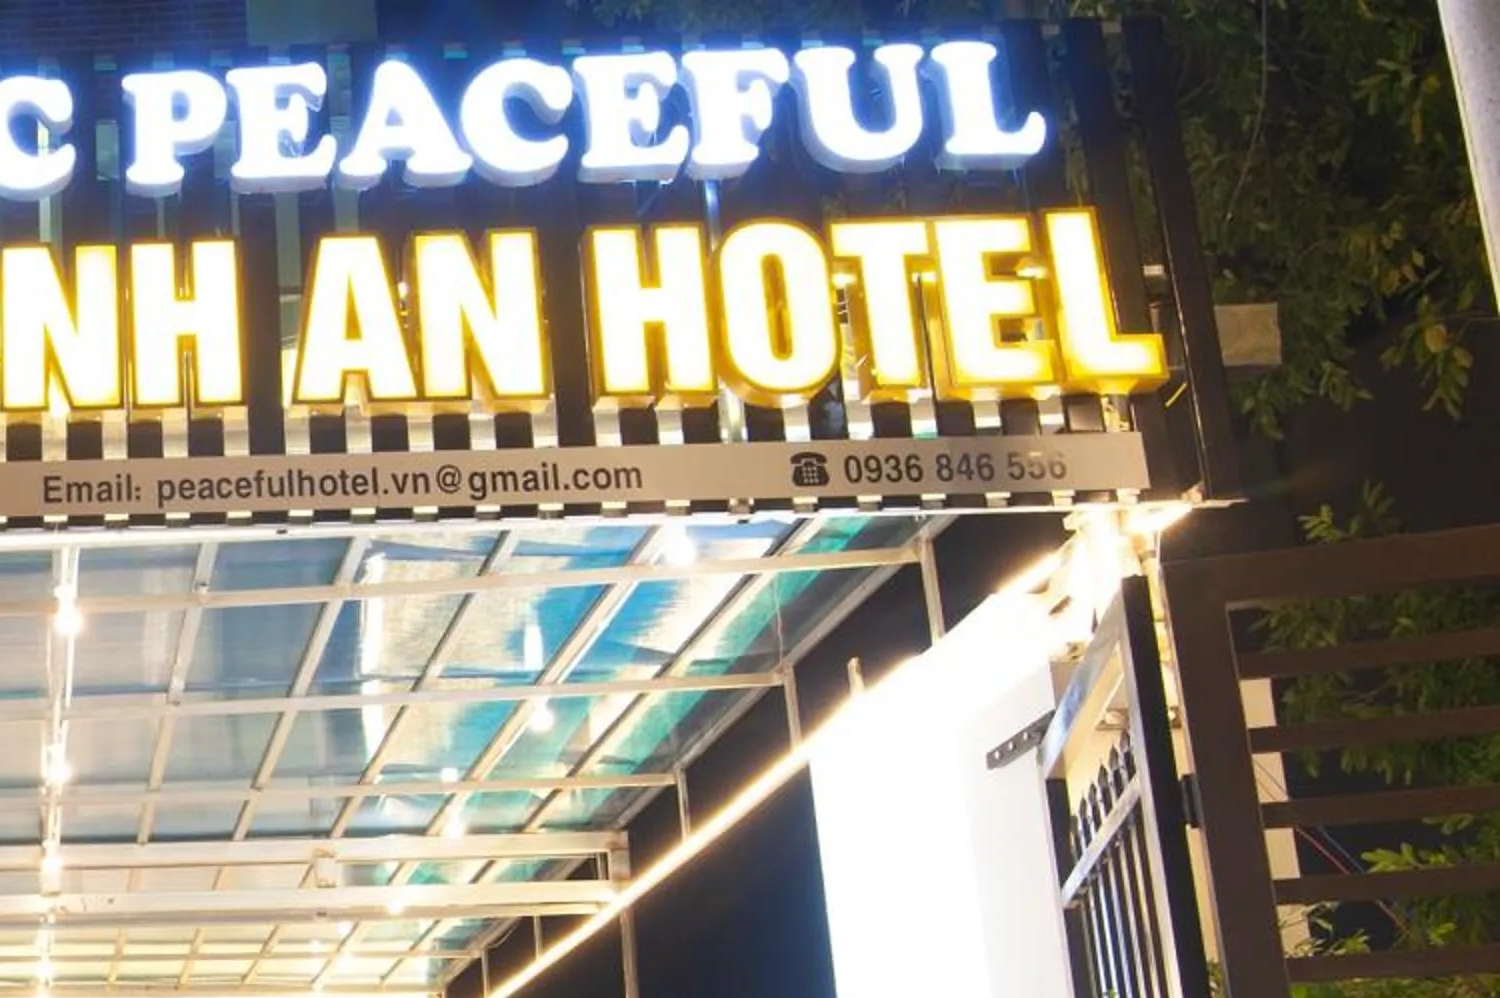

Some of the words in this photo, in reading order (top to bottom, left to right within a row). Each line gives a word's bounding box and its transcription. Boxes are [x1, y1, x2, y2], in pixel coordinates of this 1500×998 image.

[121, 40, 1047, 191] PEACEFUL
[290, 227, 550, 412] AN
[585, 206, 1165, 402] HOTEL
[43, 476, 142, 504] Email:
[156, 461, 643, 508] peacefulhotel.vn@gmail.com
[844, 454, 924, 484] 0936
[935, 453, 995, 482] 846
[1007, 451, 1068, 481] 556
